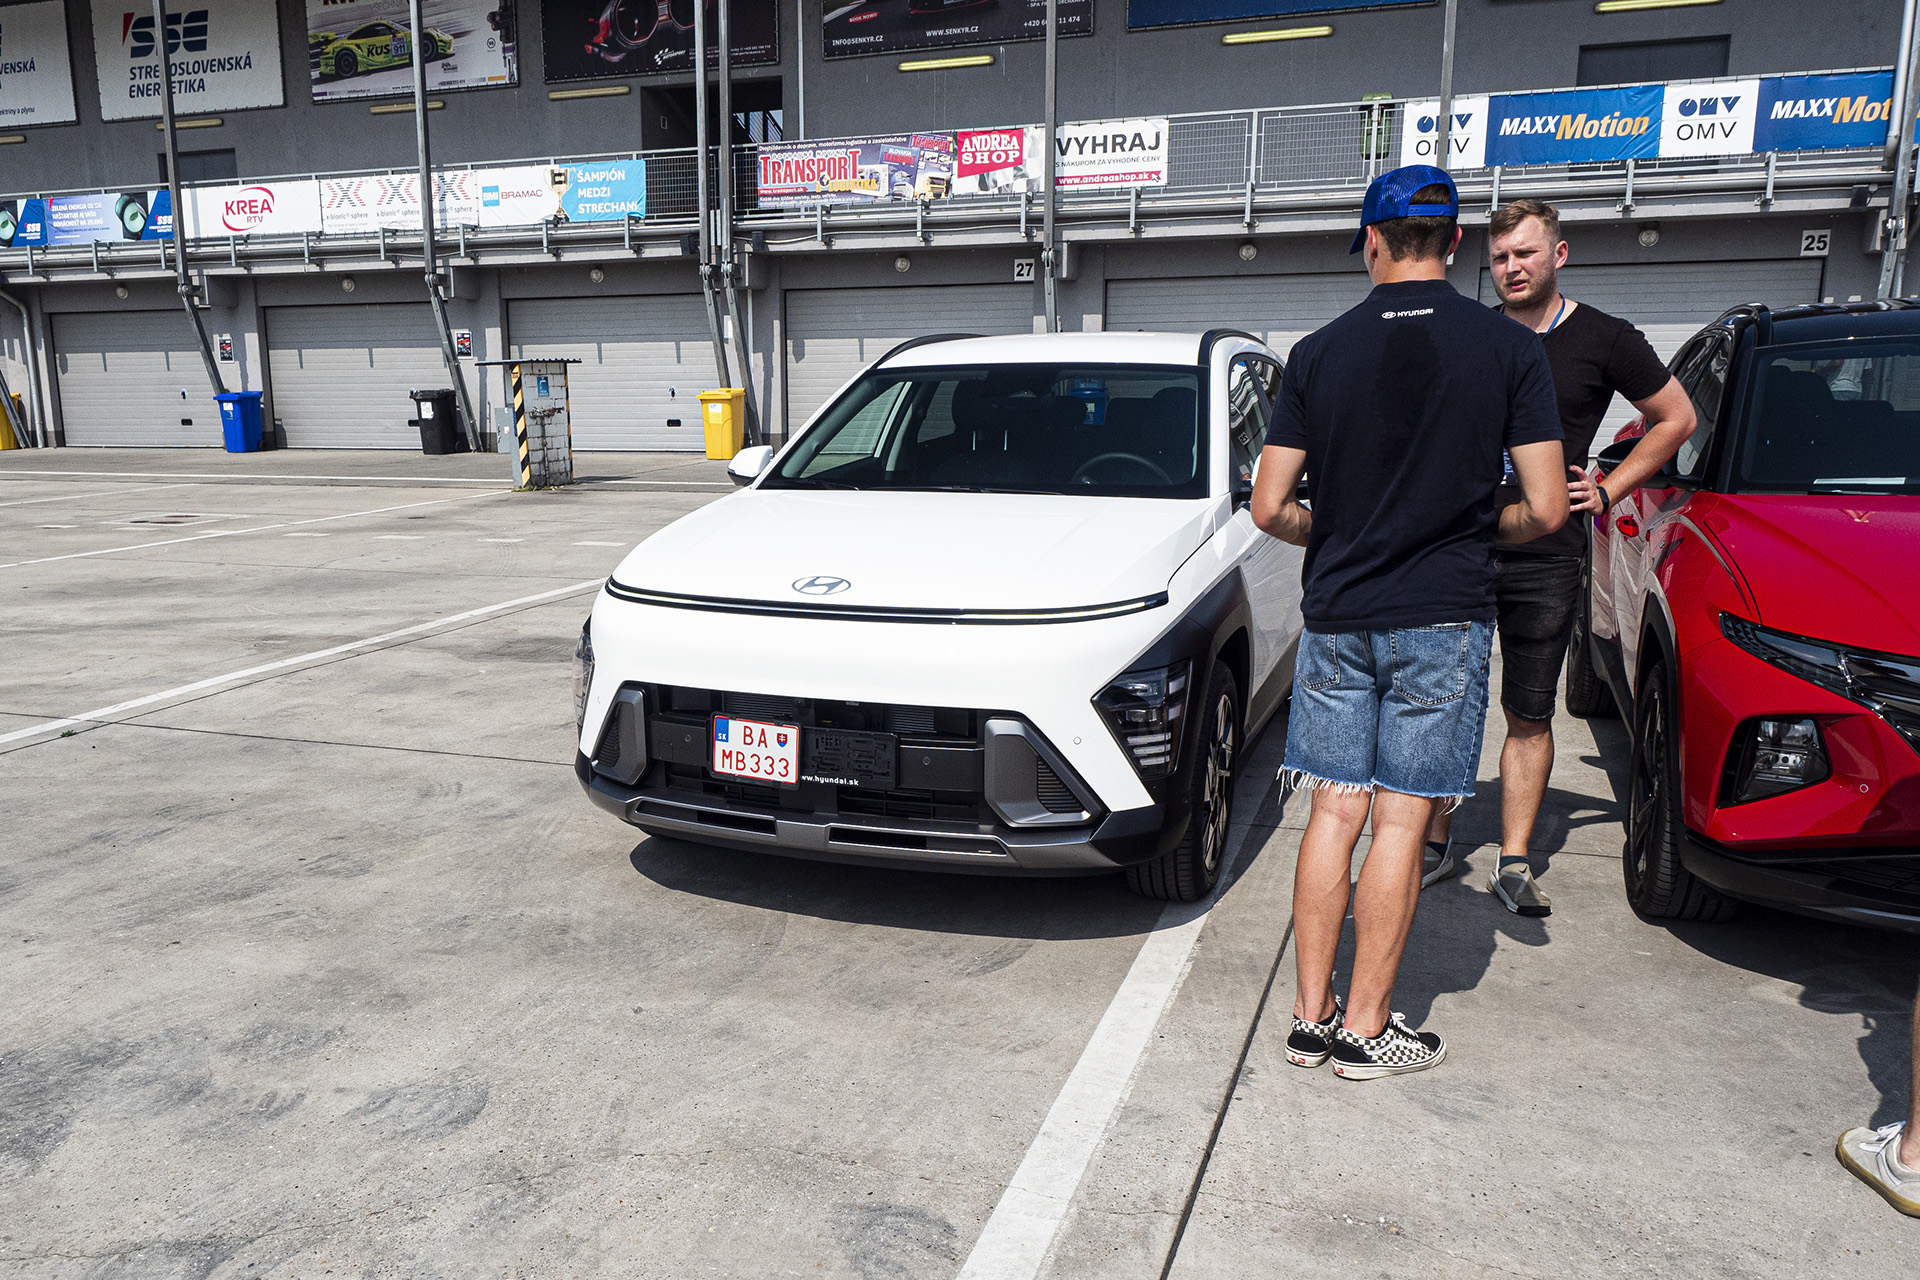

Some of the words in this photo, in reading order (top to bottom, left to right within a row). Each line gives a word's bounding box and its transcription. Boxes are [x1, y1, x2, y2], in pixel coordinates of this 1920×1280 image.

[1024, 19, 1040, 27] +420
[926, 26, 979, 37] WWW.SENKYR.CZ
[832, 35, 884, 46] INFO@SENKYR.CZ
[393, 44, 406, 54] 911
[129, 51, 252, 80] STREOSLOVENSKÁ
[129, 78, 206, 98] ENERETIKA
[1770, 96, 1893, 124] MAXXMot
[1676, 121, 1738, 141] OMV
[912, 135, 953, 152] TRANSPORT
[961, 134, 1020, 151] ANDREA
[1055, 131, 1161, 157] VYHRAJ
[883, 151, 917, 166] TRANSPORT
[889, 148, 912, 157] SLOVAKIA
[961, 150, 1020, 165] SHOP
[760, 151, 860, 184] TRANSPORT
[1097, 157, 1107, 165] ZA
[577, 168, 626, 183] ŠAMPIÓN
[1059, 171, 1149, 184] www.andreashop.sk
[828, 178, 878, 192] LOGISTIKA
[483, 191, 499, 201] BMI
[501, 189, 543, 199] BRAMAC
[577, 187, 611, 198] MEDZI
[225, 199, 273, 216] KREA
[401, 208, 420, 216] sphere
[247, 215, 263, 223] RTV
[351, 212, 368, 220] sphere
[1803, 234, 1828, 251] 25
[1016, 262, 1034, 277] 27
[1397, 308, 1433, 317] HYUNDAI
[718, 732, 727, 740] SK
[743, 725, 768, 748] BA
[721, 749, 789, 777] MB333
[801, 775, 859, 786] ww.hyundai.sk
